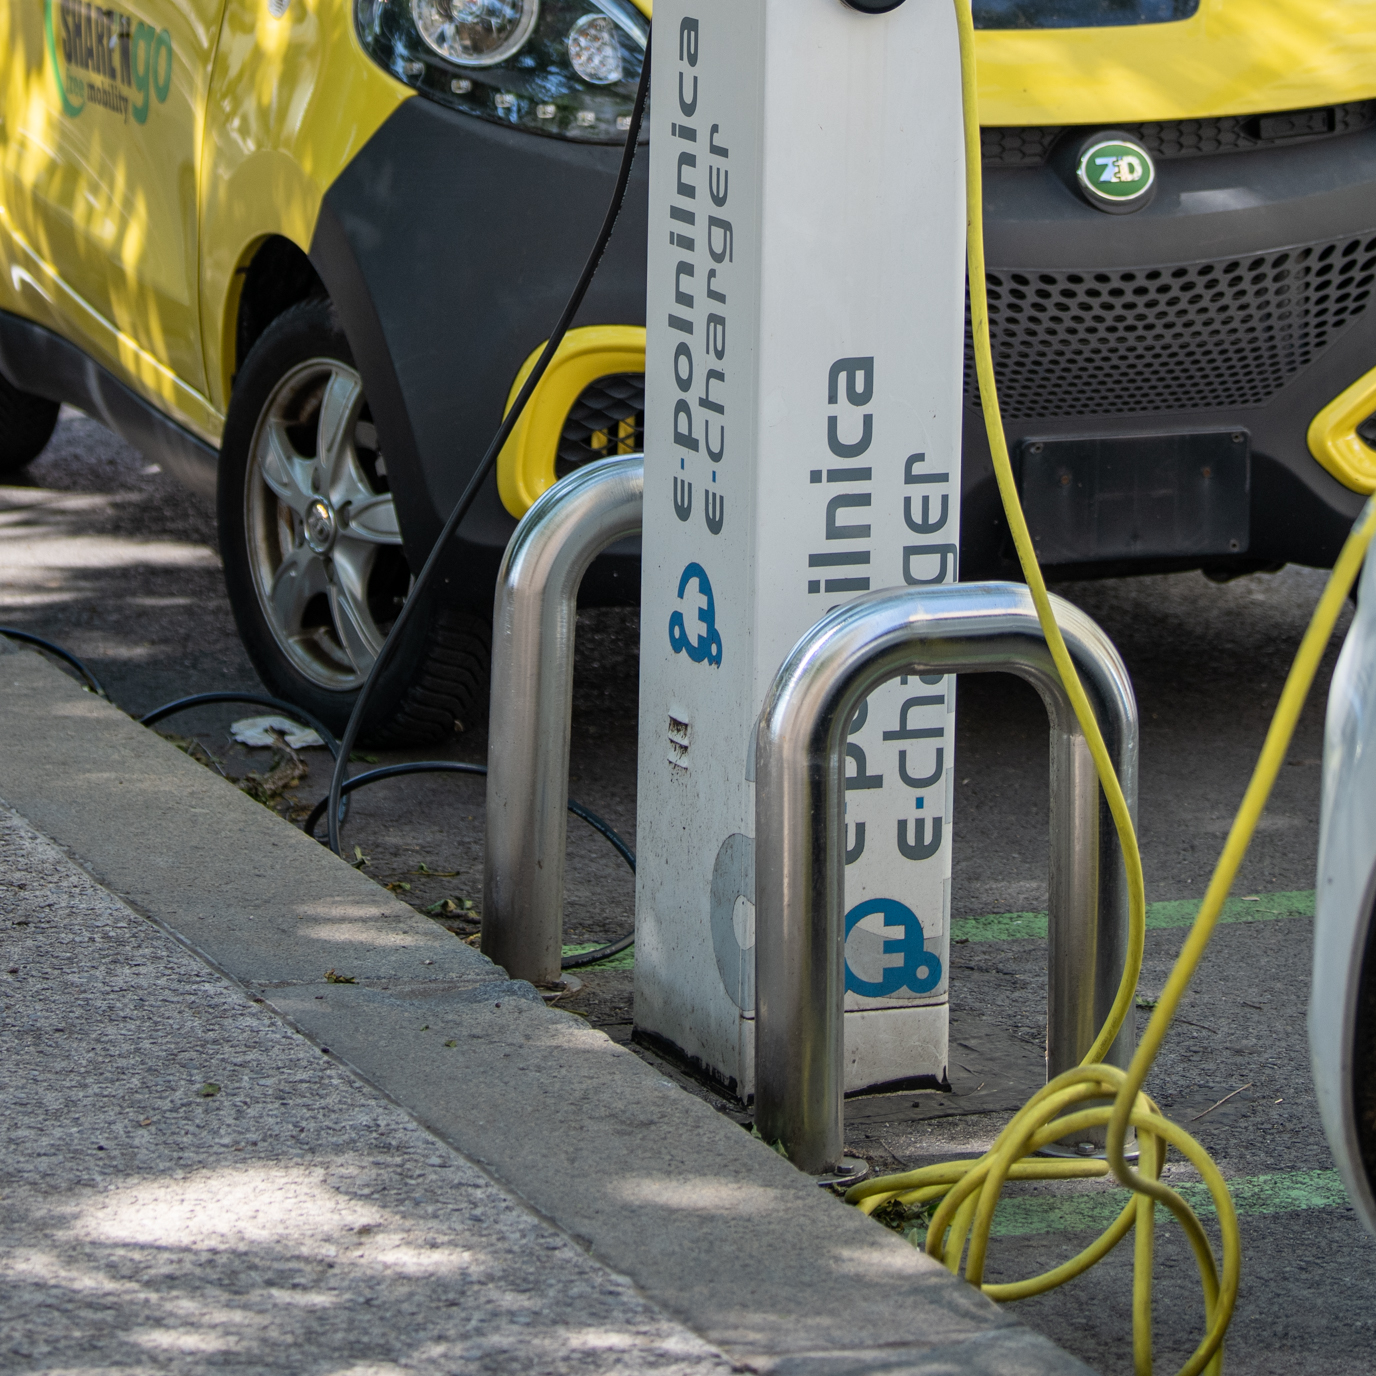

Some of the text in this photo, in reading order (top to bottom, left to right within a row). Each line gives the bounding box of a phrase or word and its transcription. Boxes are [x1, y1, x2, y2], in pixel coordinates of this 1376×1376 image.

[86, 80, 130, 124] mobility
[667, 15, 701, 523] e-polnilnica
[697, 123, 734, 536] e-charger
[882, 451, 959, 861] e-chger
